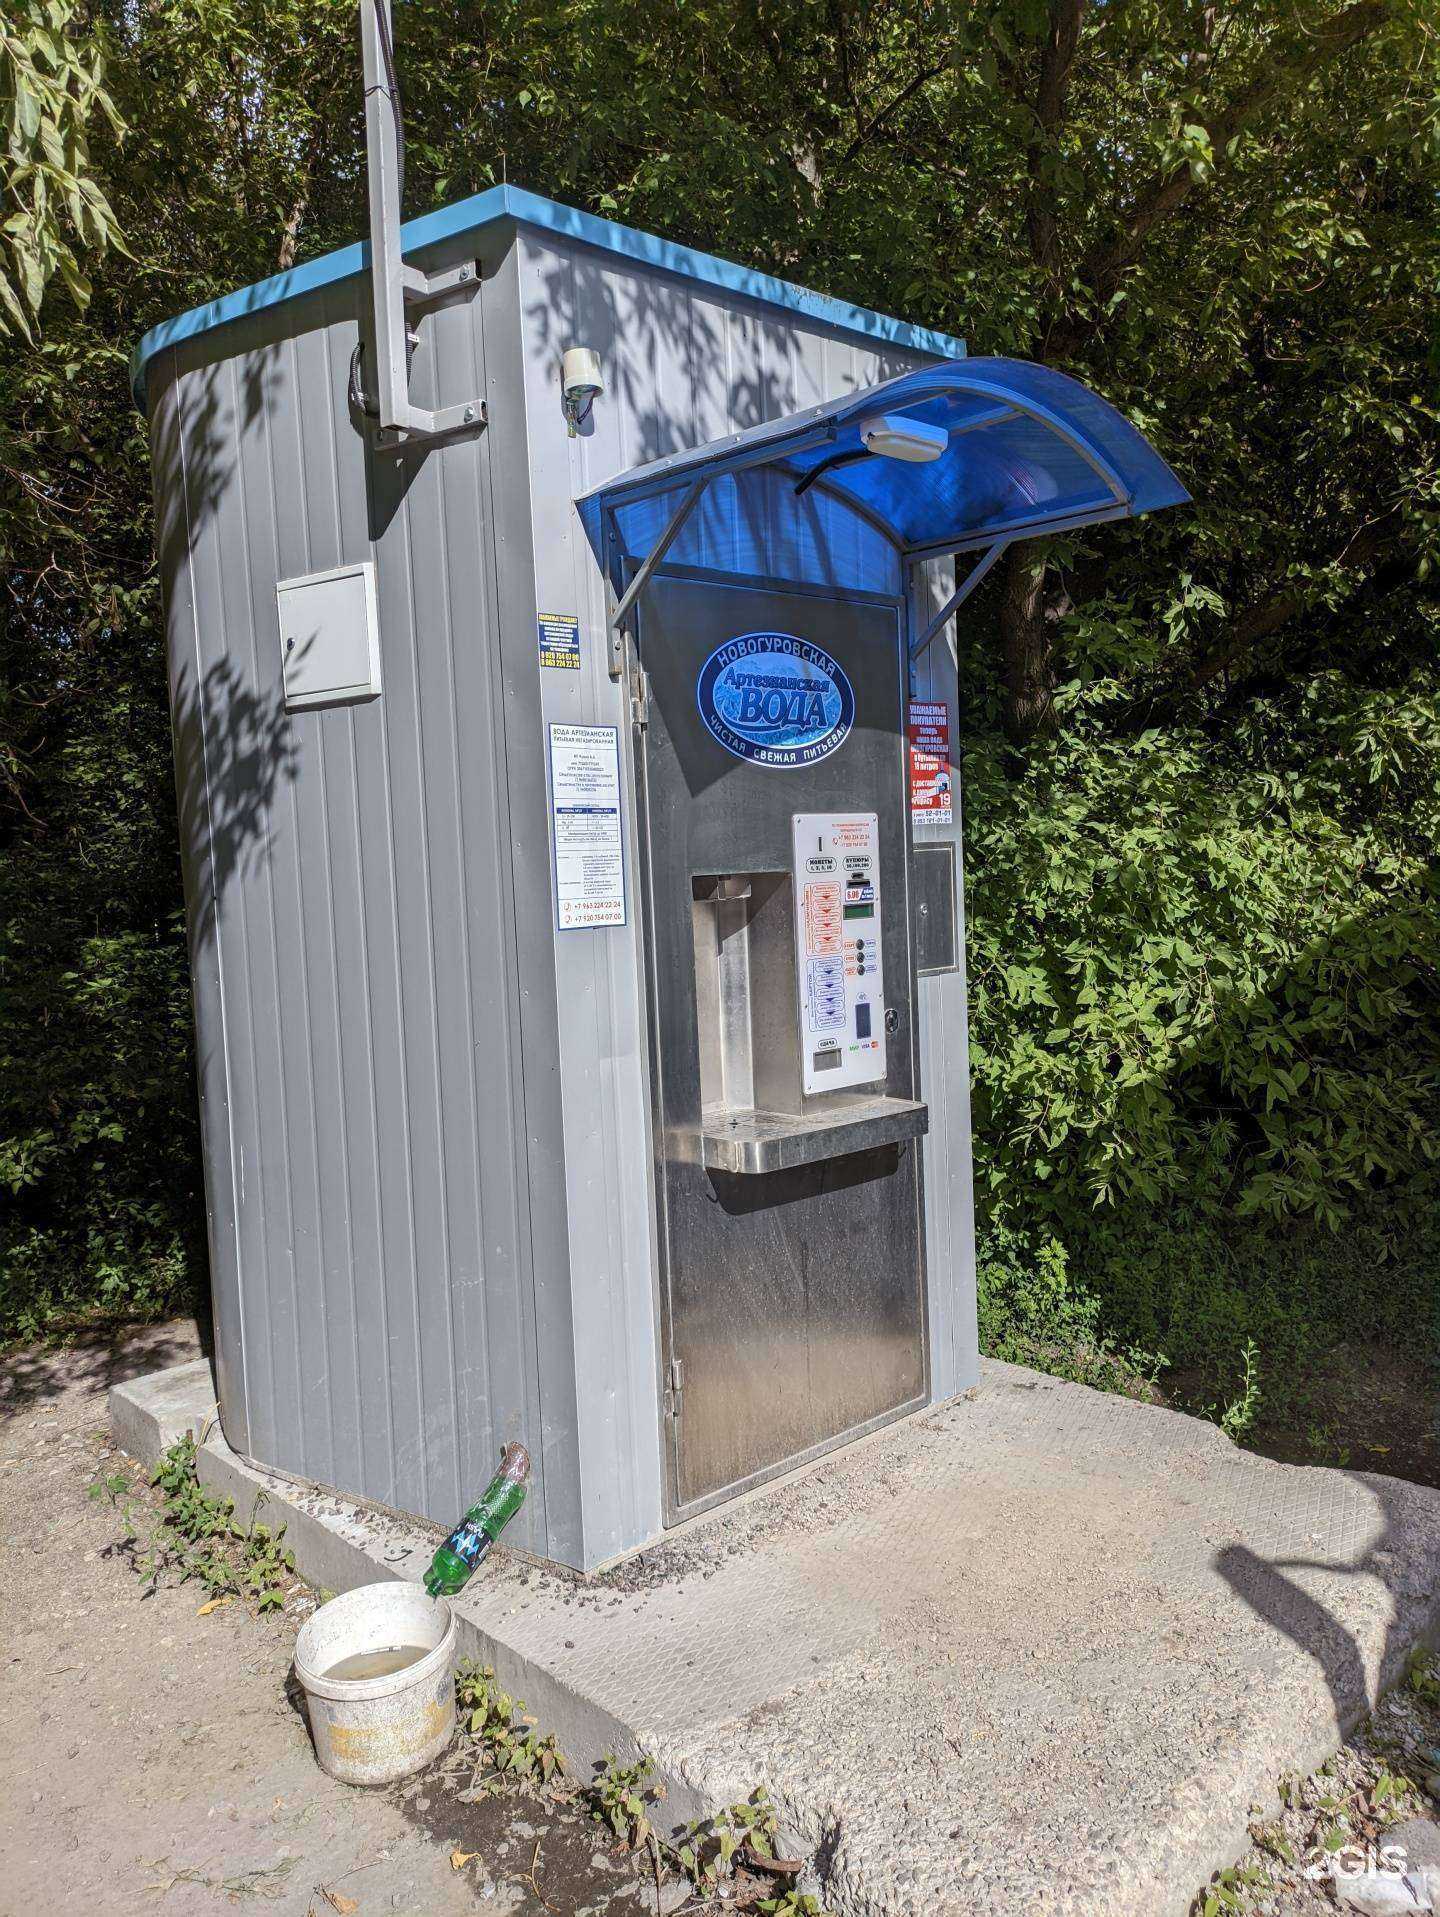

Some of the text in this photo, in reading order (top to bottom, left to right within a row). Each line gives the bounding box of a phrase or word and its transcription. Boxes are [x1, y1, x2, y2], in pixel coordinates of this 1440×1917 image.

[717, 637, 837, 677] НОВОГУРОВСКАЯ
[723, 666, 831, 693] Артезианская
[736, 687, 829, 731] ВОДА
[909, 704, 946, 716] УВАЖАЕМЫЕ
[910, 715, 947, 726] ПОКУПАТЕЛИ
[553, 727, 570, 736] ВОДА
[711, 714, 747, 753] ЧИСТАЯ
[803, 722, 847, 760] ПИТЬЕВАЯ
[753, 748, 797, 763] СВЕЖАЯ
[939, 792, 951, 806] 19
